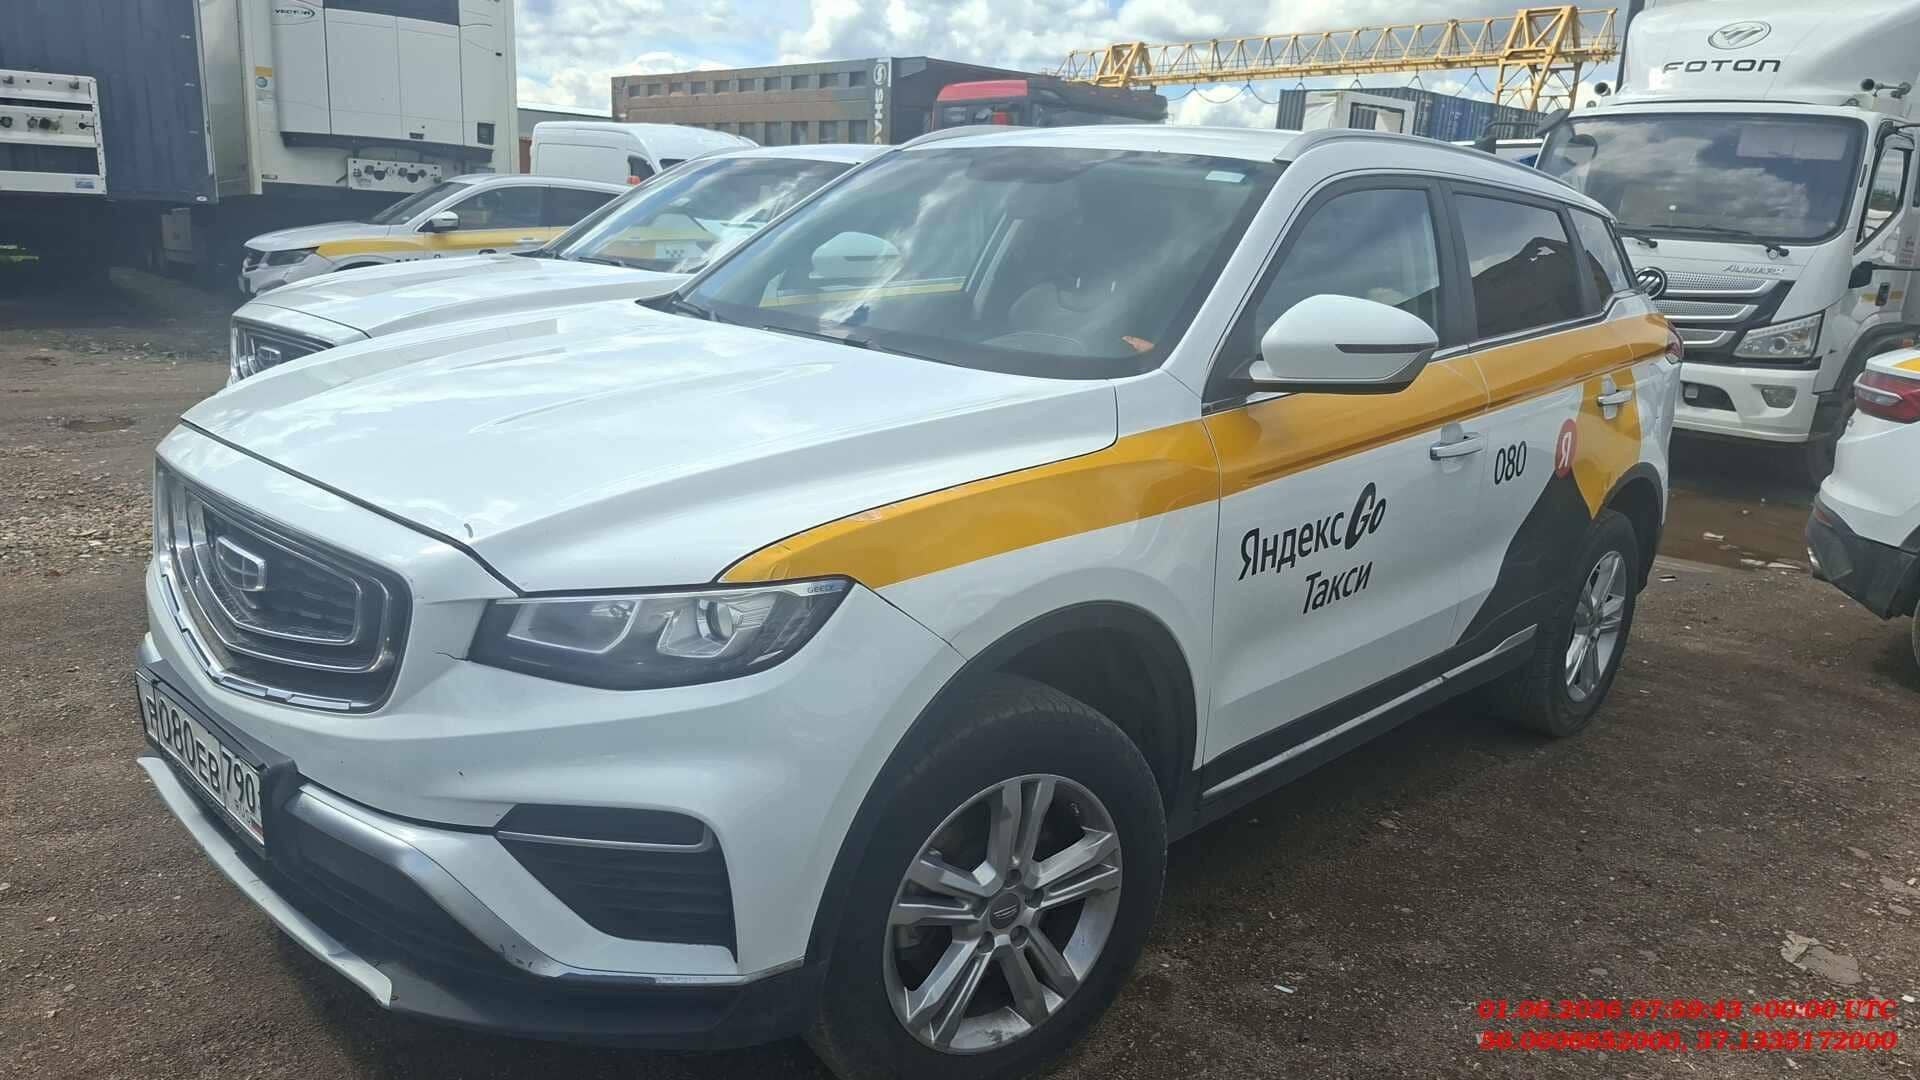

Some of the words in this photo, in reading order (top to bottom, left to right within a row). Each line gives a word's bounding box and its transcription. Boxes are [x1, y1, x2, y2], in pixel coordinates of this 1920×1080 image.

[1662, 59, 1781, 74] FOTON
[1493, 440, 1527, 485] 080
[1238, 511, 1345, 581] Яндекс
[1344, 481, 1388, 551] Go
[1302, 561, 1373, 615] Такси
